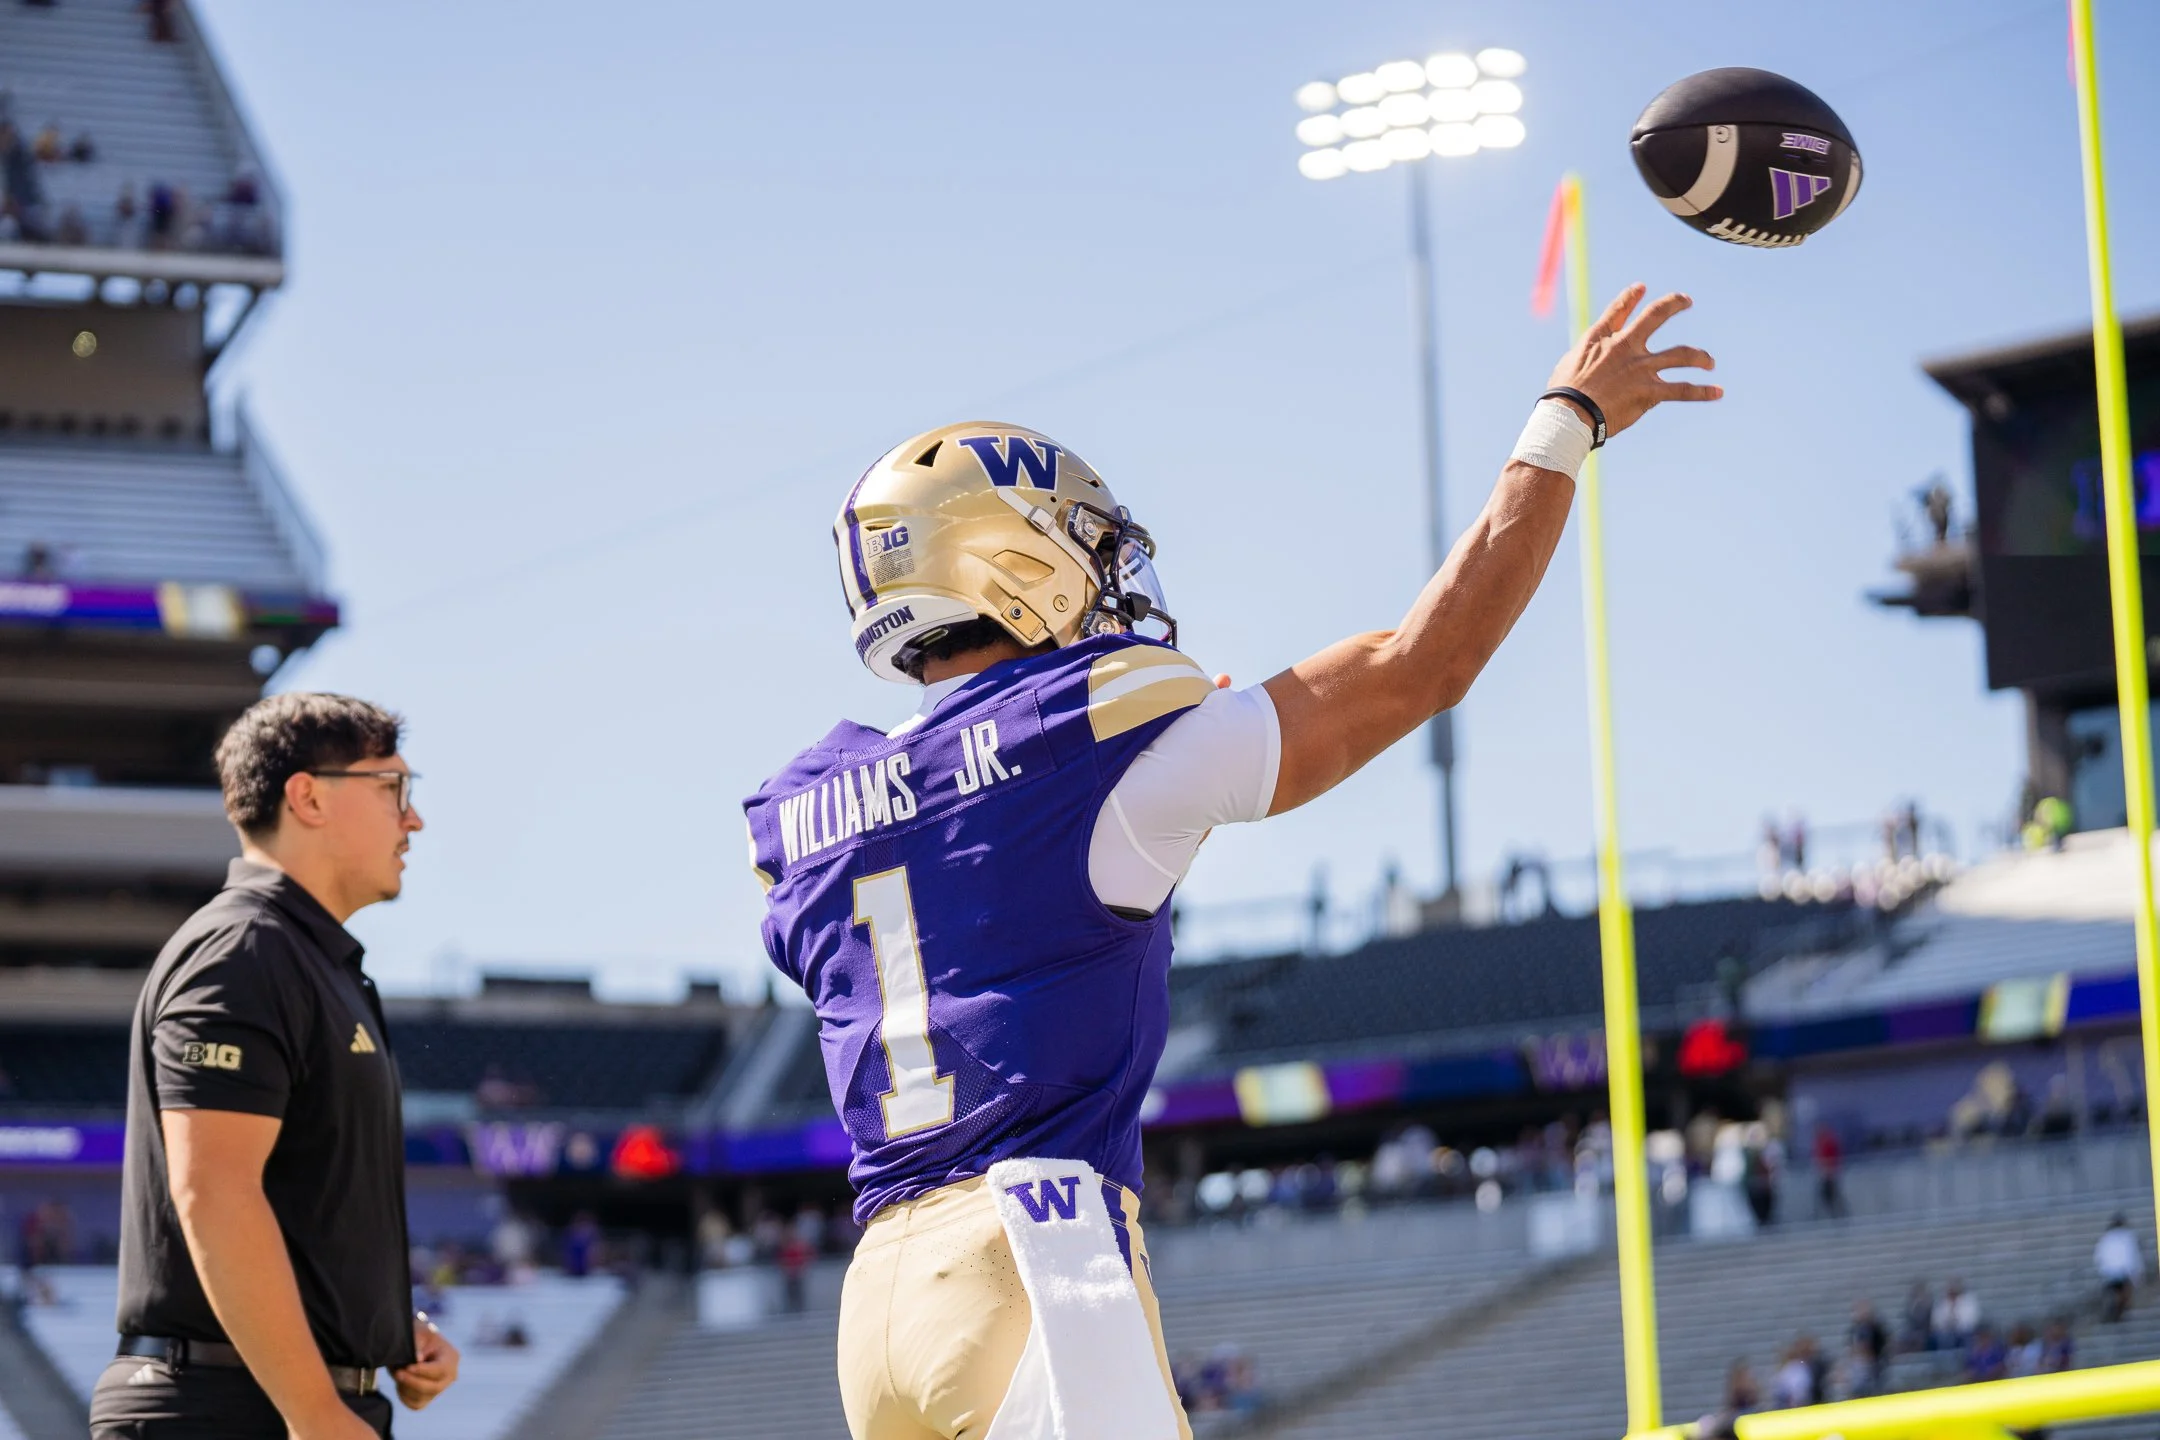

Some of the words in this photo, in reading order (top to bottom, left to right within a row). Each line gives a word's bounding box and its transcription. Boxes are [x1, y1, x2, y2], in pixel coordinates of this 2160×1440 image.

[957, 435, 1065, 492] W
[778, 752, 918, 867] WILLIAMS
[954, 719, 1022, 796] JR.
[852, 864, 955, 1140] 1
[1004, 1175, 1081, 1223] W
